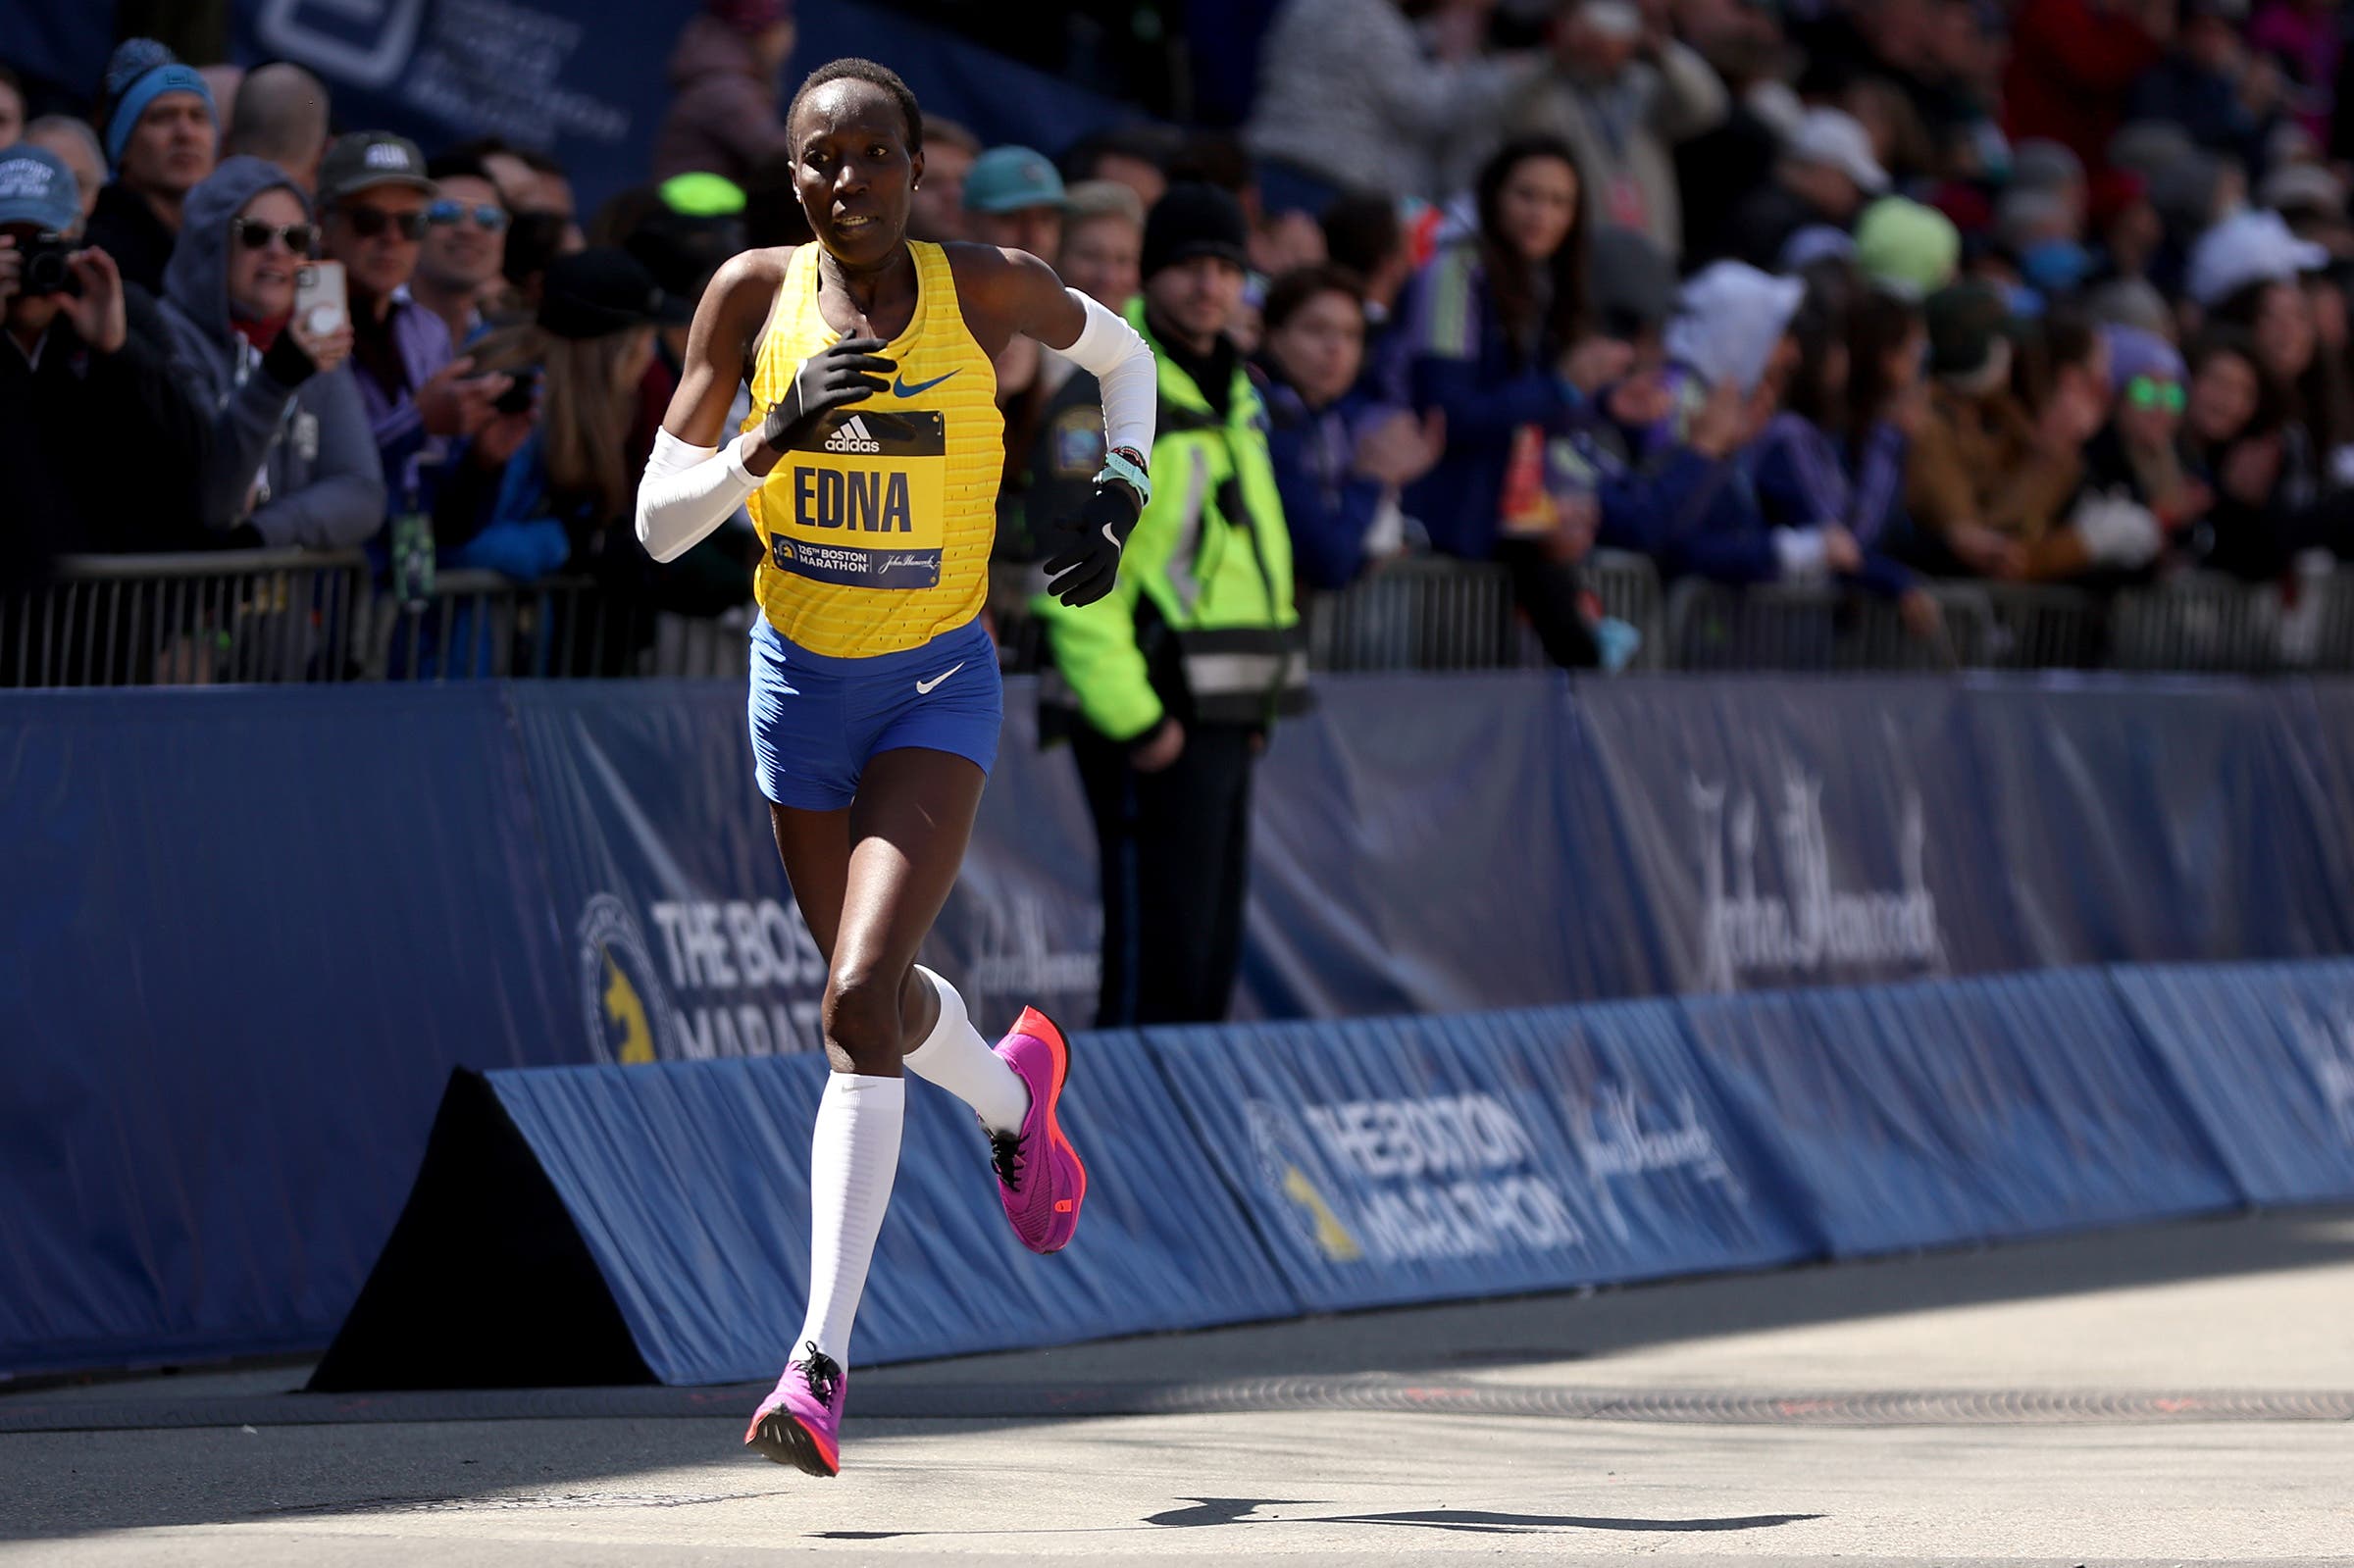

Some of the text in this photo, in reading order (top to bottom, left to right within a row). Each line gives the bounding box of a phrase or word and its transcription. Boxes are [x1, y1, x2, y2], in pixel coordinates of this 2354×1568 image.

[825, 438, 880, 453] adidas
[793, 466, 912, 532] EDNA
[797, 543, 867, 563] 126TH BOSTON
[651, 901, 738, 989] THE
[1305, 1100, 1399, 1177] THE
